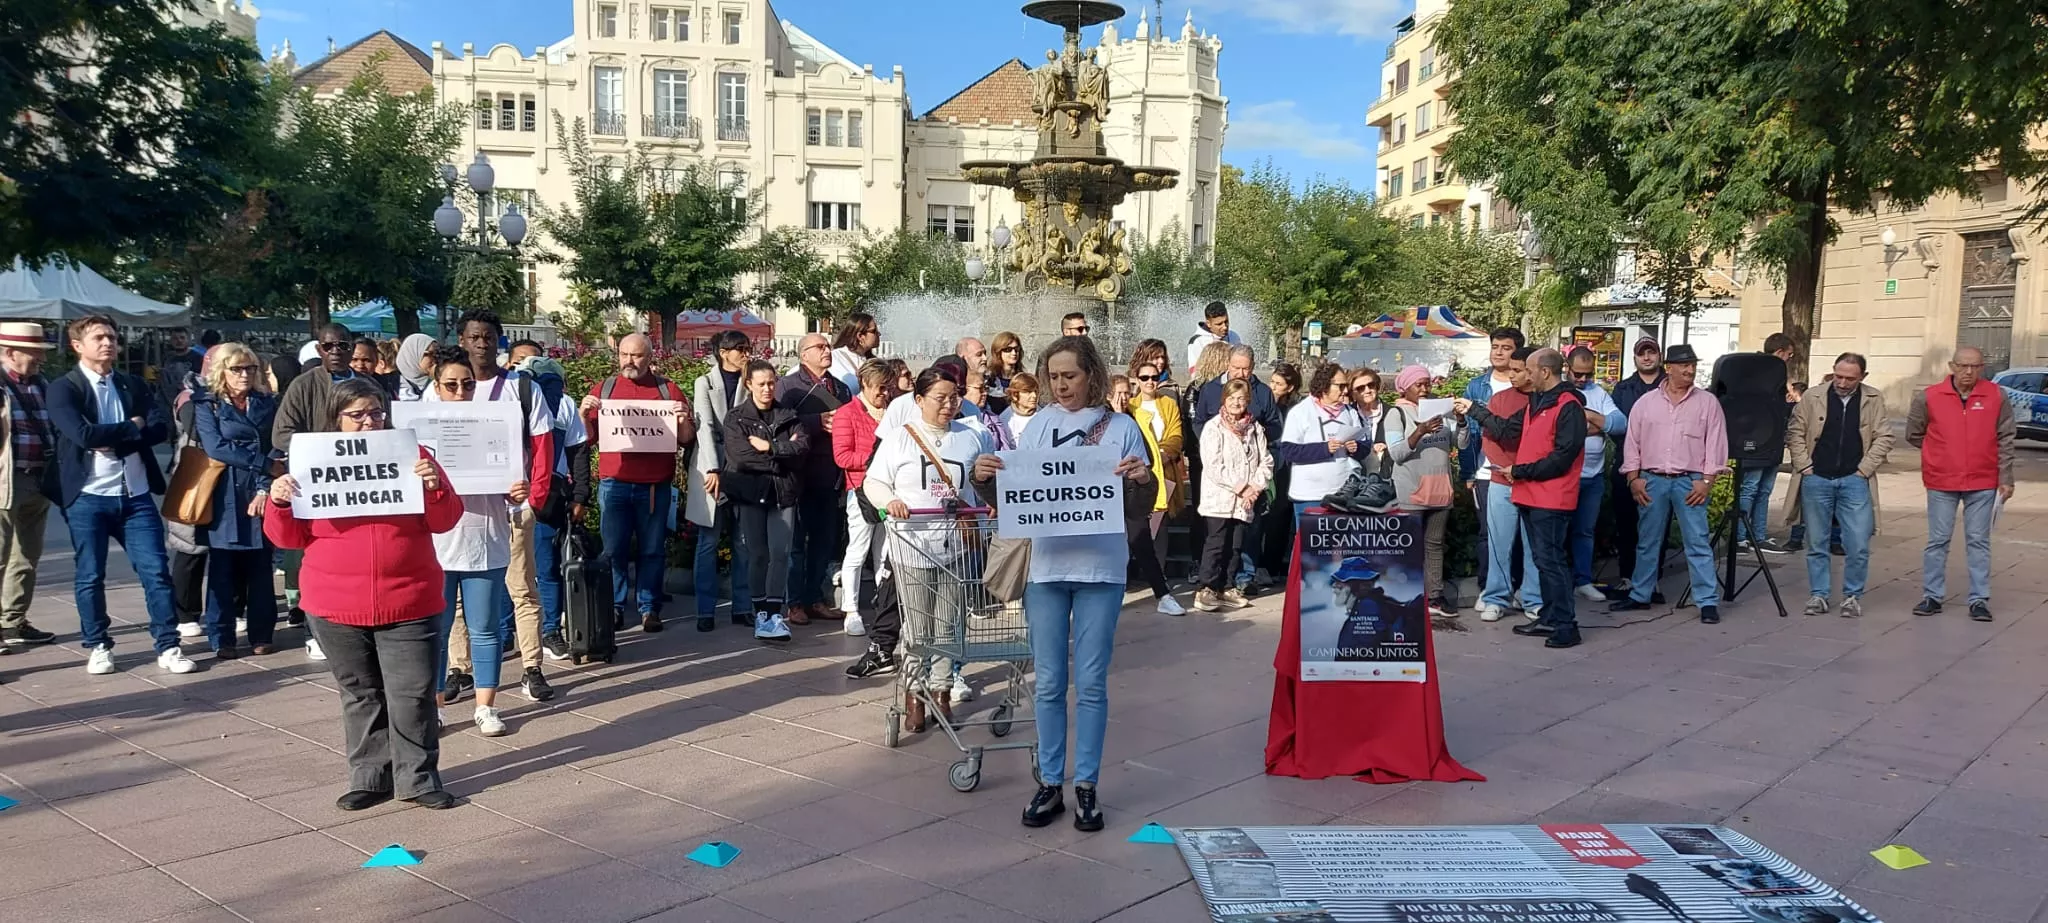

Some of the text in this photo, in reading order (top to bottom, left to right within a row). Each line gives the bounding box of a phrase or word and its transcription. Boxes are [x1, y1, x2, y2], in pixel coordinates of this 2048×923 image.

[602, 408, 674, 416] CAMINEMOS
[612, 427, 664, 436] JUNTAS
[335, 438, 368, 456] SIN
[310, 463, 400, 484] PAPELES
[1042, 460, 1076, 476] SIN
[312, 490, 404, 508] SIN HOGAR
[1005, 485, 1114, 504] RECURSOS
[1018, 510, 1104, 524] SIN HOGAR
[1318, 517, 1400, 530] EL CAMINO
[1310, 534, 1412, 547] DE SANTIAGO
[1308, 648, 1418, 658] CAMINEMOS JUNTOS
[1572, 849, 1636, 857] HOGAR
[1396, 904, 1463, 912] VOLVER
[1526, 904, 1538, 912] A
[1539, 903, 1598, 911] ESTAR
[1406, 915, 1418, 923] A
[1515, 913, 1618, 922] PARTICIPAR
